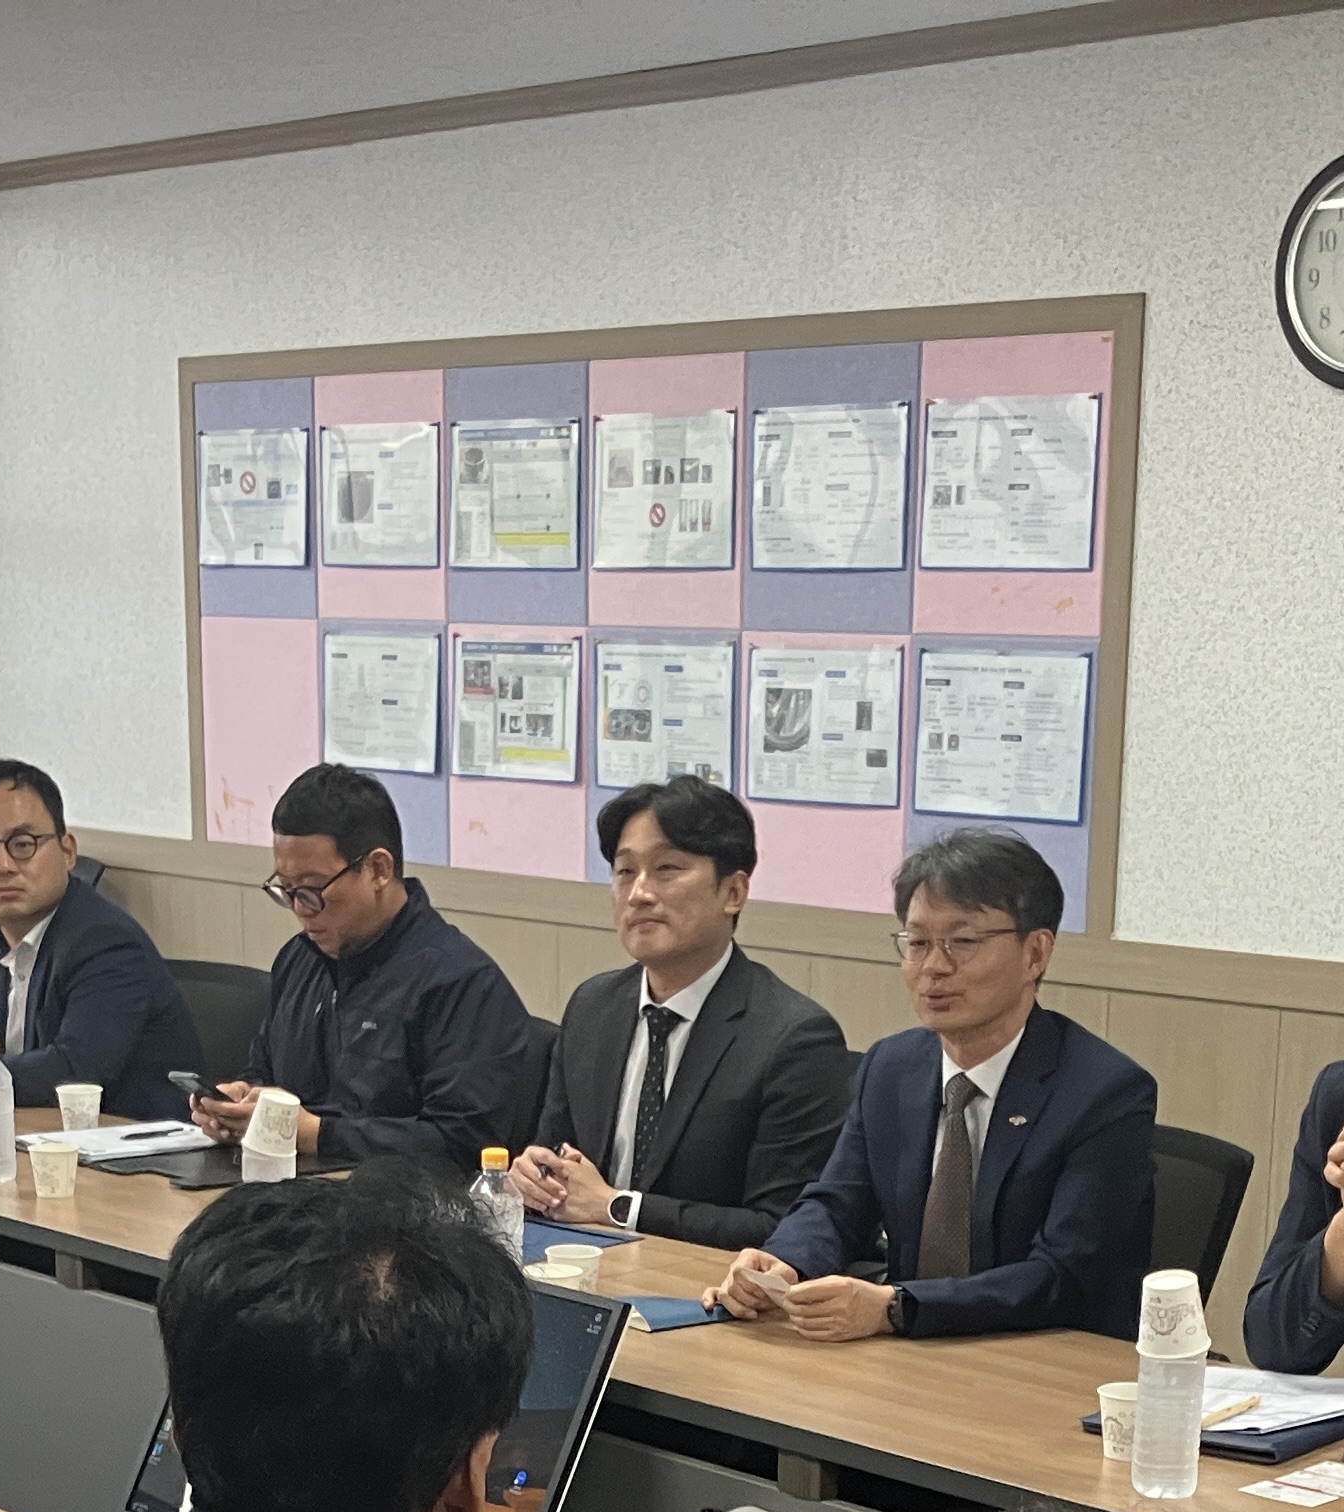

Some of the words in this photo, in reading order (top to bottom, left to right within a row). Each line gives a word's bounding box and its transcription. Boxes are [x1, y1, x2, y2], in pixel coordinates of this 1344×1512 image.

[1318, 228, 1337, 253] 10
[1308, 267, 1320, 291] 9
[1319, 305, 1331, 330] 8
